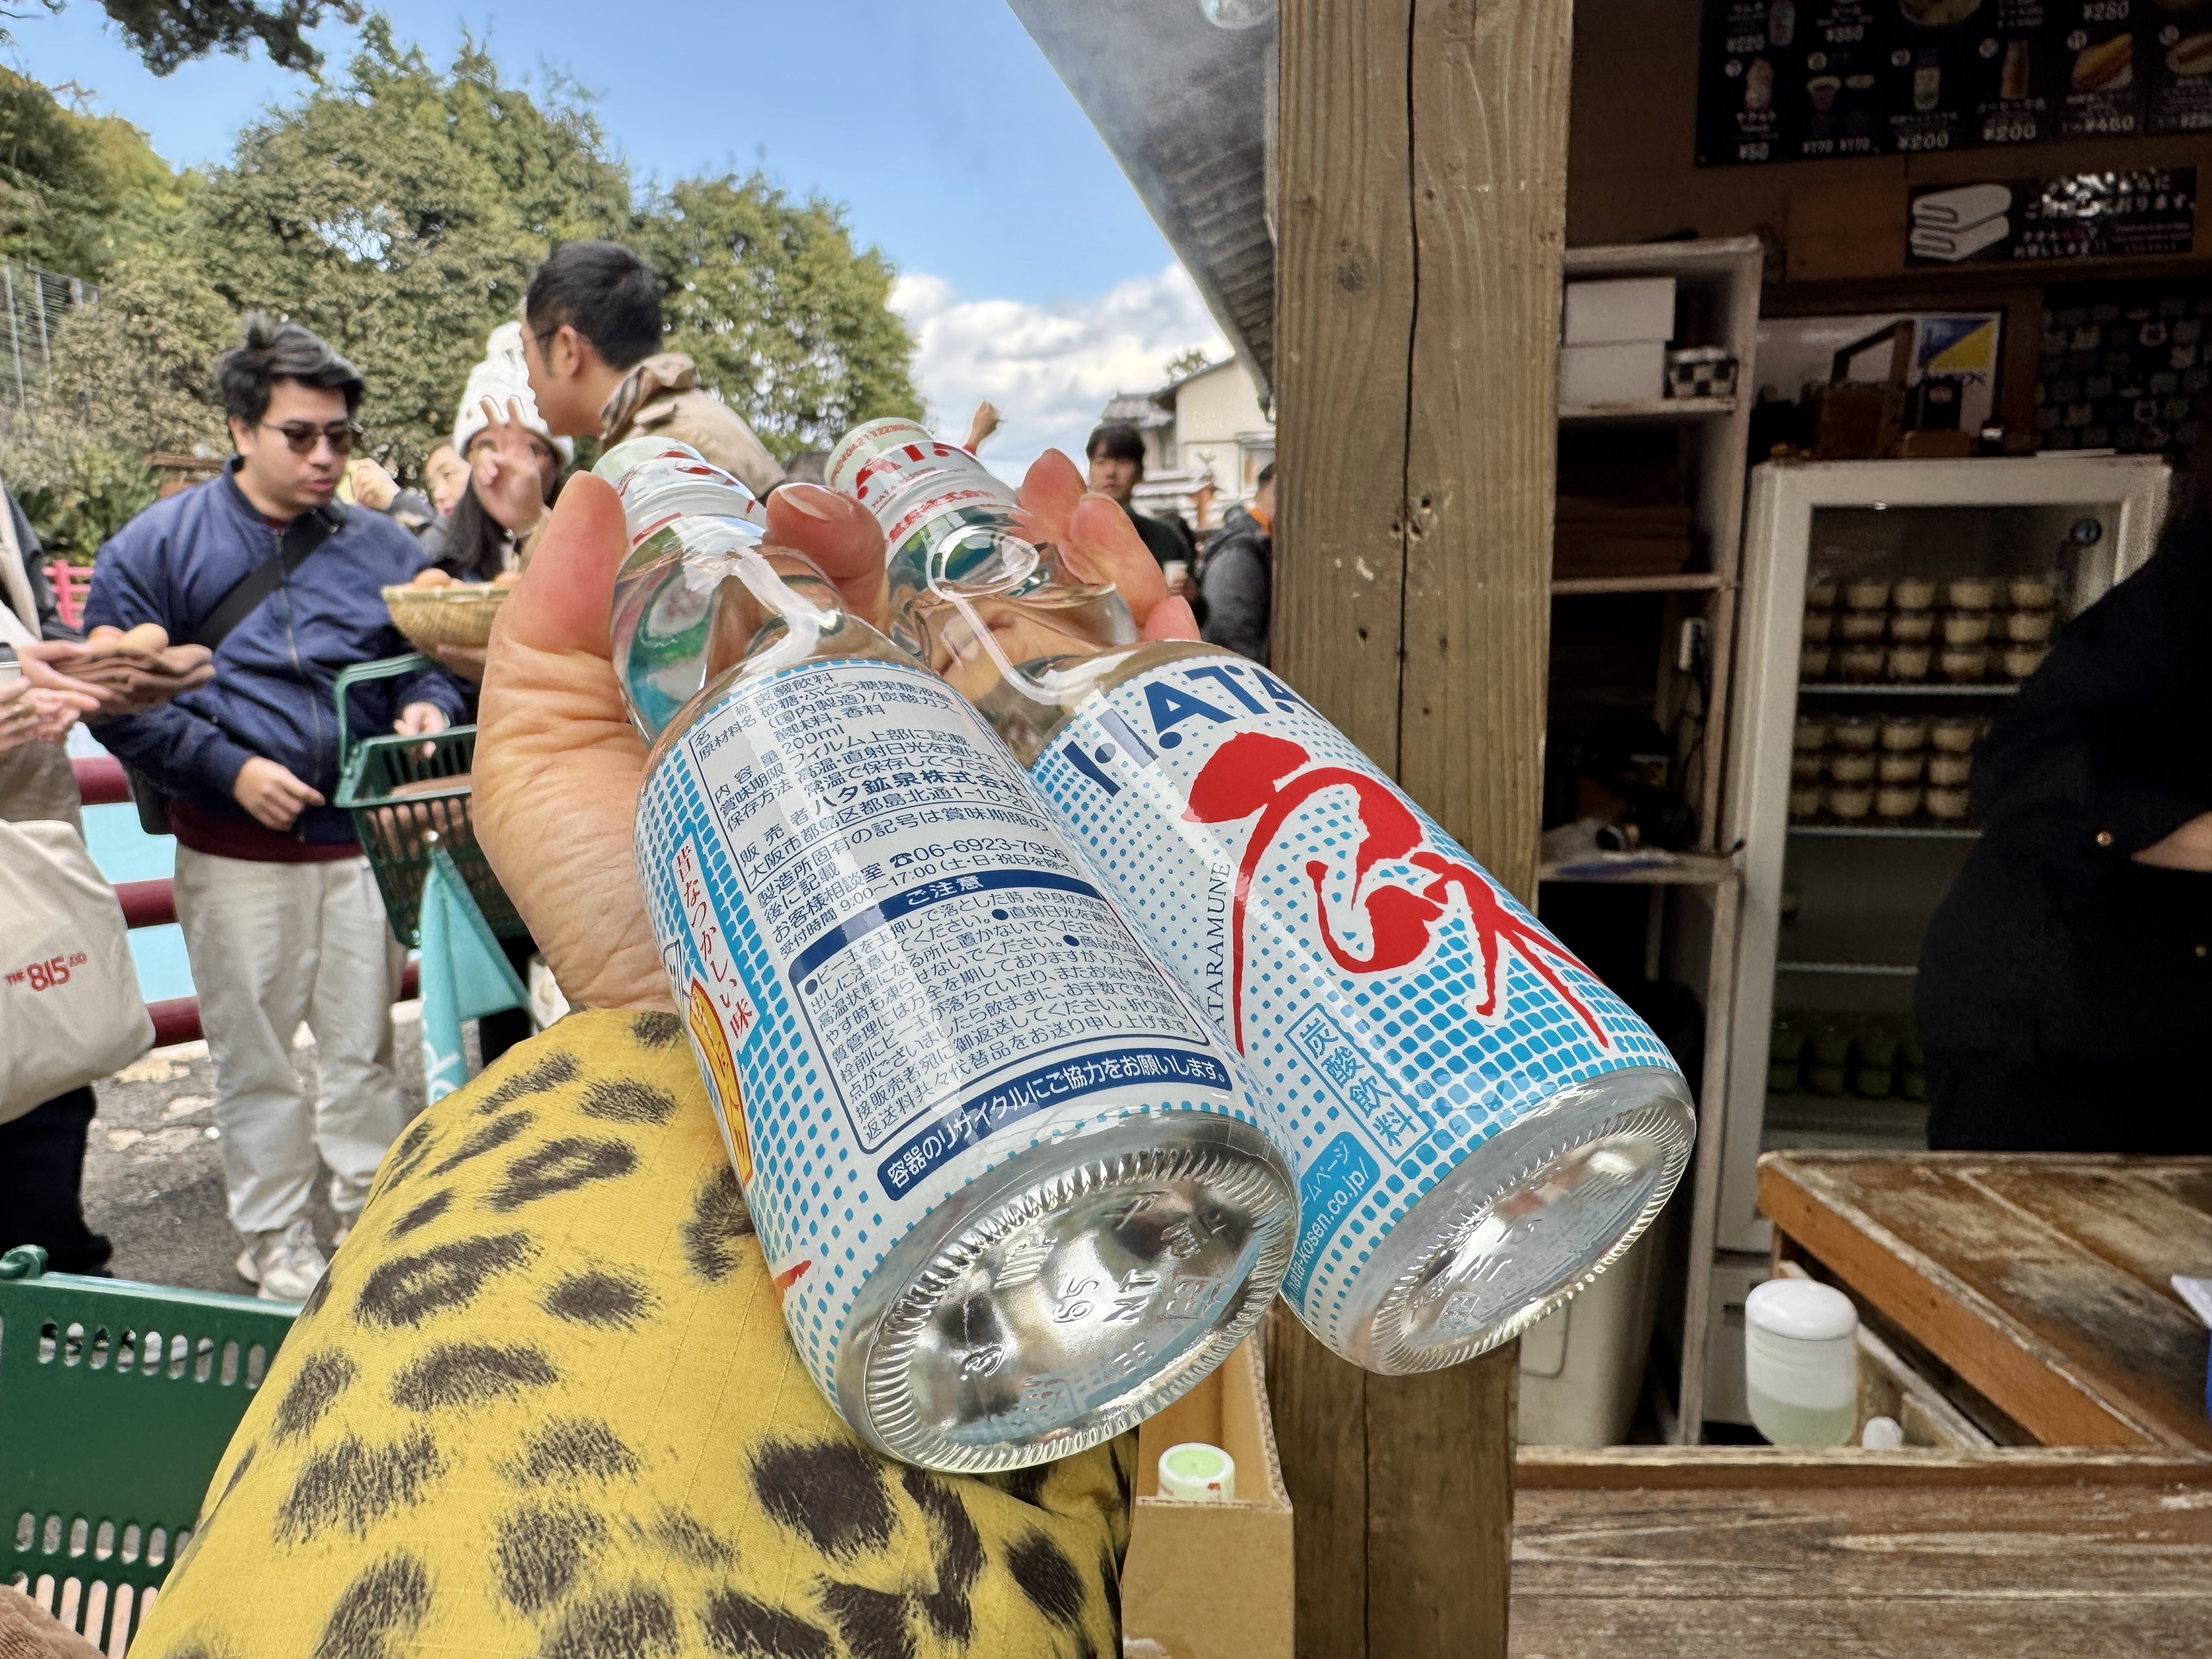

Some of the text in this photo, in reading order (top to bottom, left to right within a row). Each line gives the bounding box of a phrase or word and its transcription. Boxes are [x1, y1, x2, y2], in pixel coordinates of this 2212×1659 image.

[782, 724, 845, 755] 200ml
[720, 763, 786, 819] 賞味期限
[727, 779, 793, 832] 保存方法
[816, 770, 1026, 815] ハタ鉱泉株式会社
[758, 807, 1048, 909] 製造所固有の記号は賞味期限の
[765, 862, 840, 925] 後に記載
[772, 863, 886, 943] お客様相談室
[905, 874, 984, 906] ご注意
[675, 845, 753, 1040] 昔なつかしい味
[780, 907, 838, 961] 受付時間
[27, 956, 70, 992] 815
[1299, 1017, 1418, 1148] 炭酸飲料
[887, 1054, 1226, 1188] 容器のリサイクルにご協力をお願いします。
